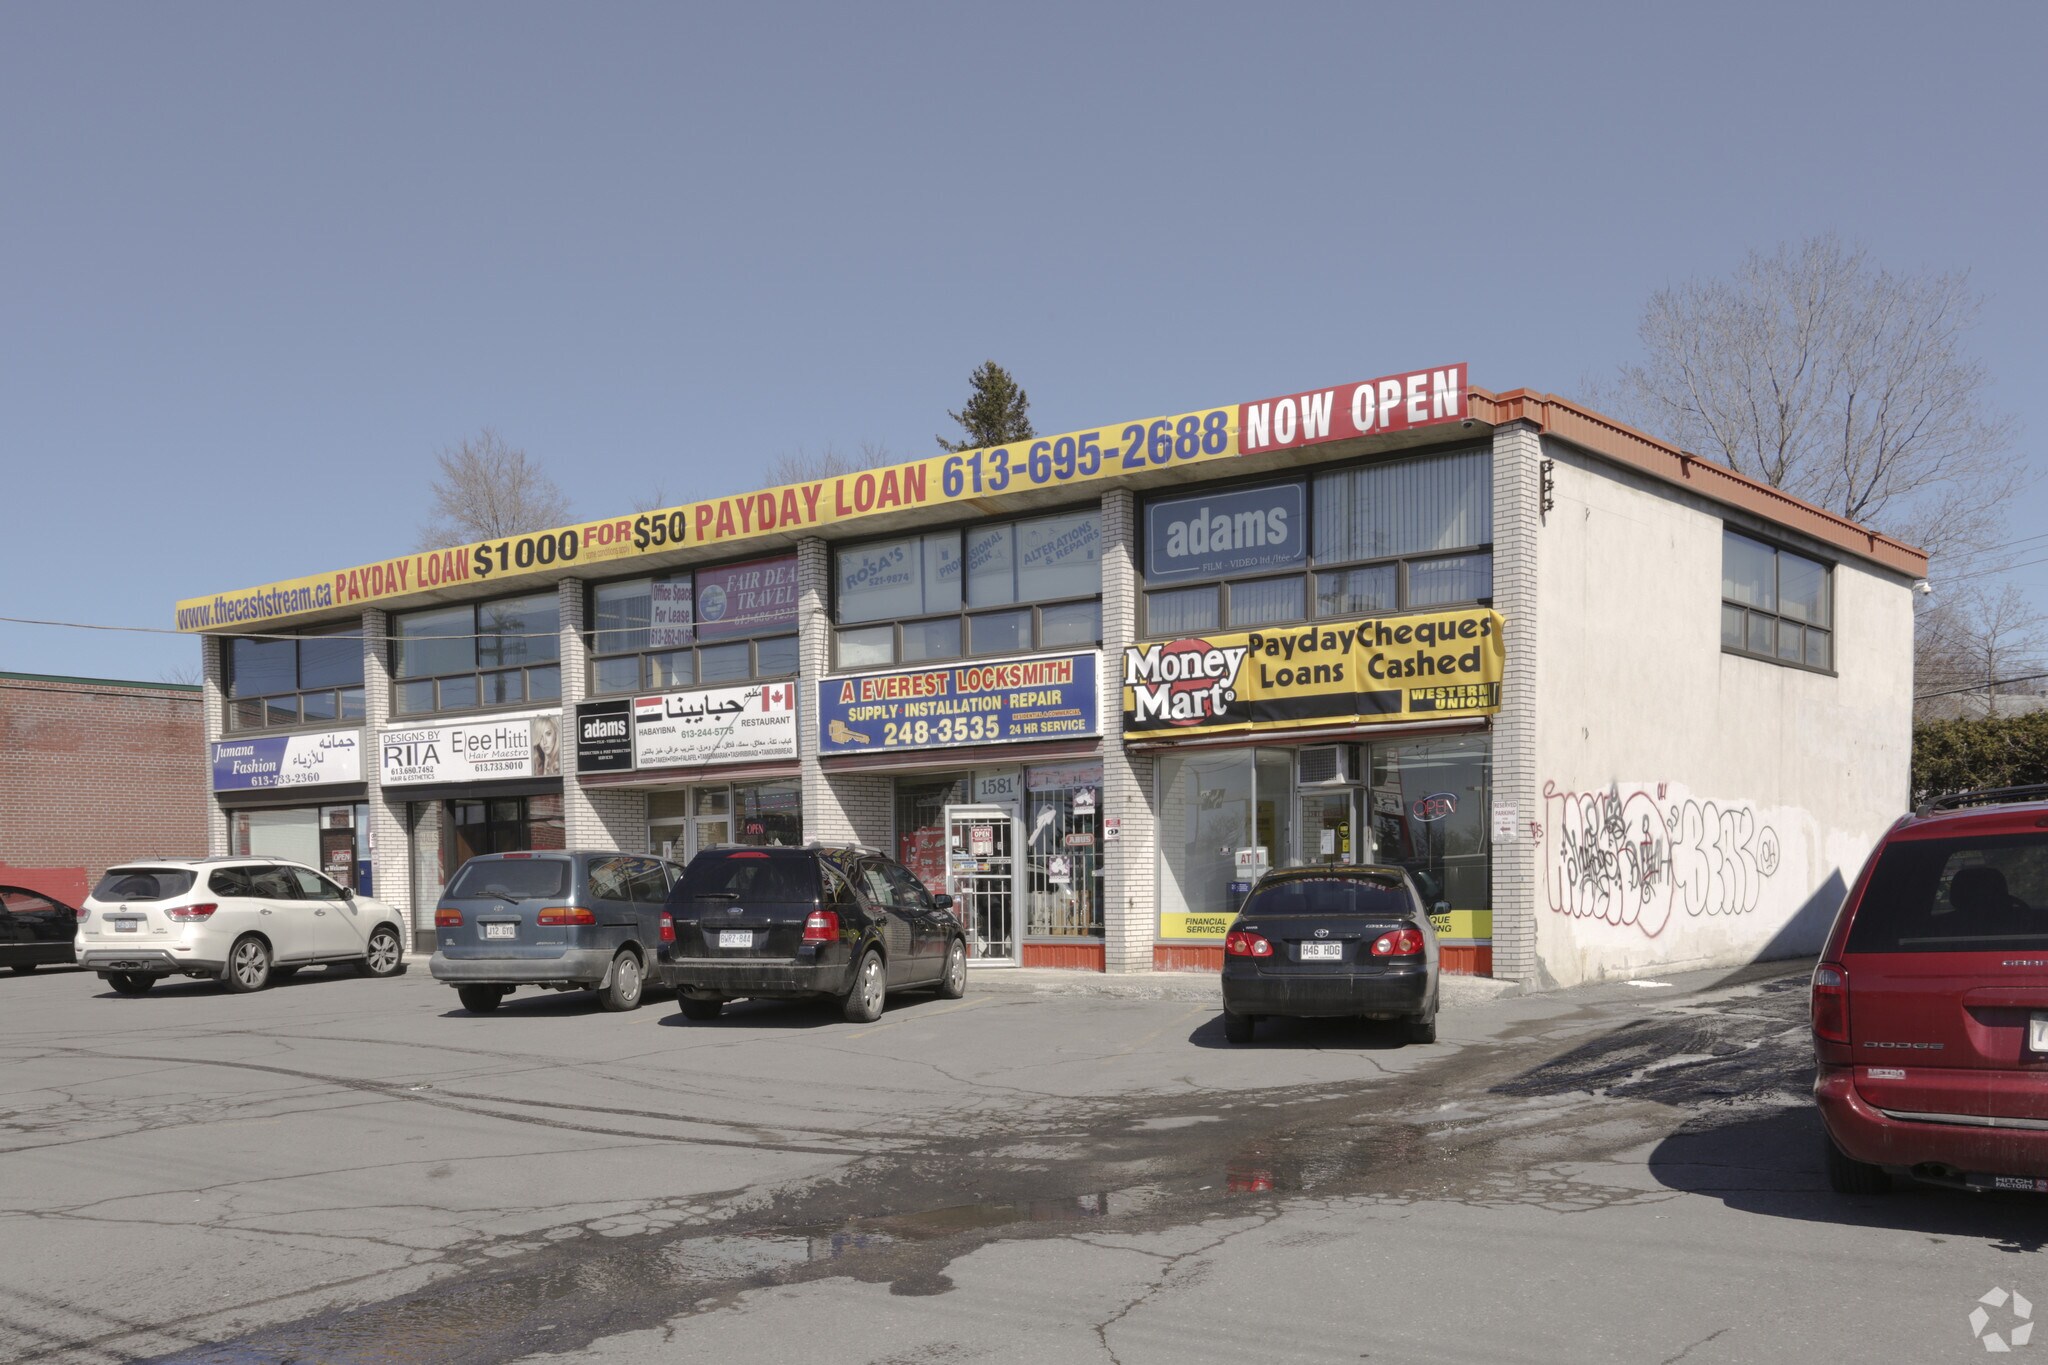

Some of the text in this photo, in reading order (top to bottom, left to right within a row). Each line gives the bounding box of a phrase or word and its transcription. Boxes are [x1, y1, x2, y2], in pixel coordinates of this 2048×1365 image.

[1247, 368, 1458, 449] NOW OPEN
[178, 410, 1228, 630] www.thecashstream.ca PAYDAY LOAN $1000 FOR $50 PAYDAY LOAN 613-695-2688
[1166, 506, 1288, 558] adams
[1024, 521, 1092, 565] ALTERATIONS
[1055, 529, 1100, 559] REPAIRS
[1202, 561, 1222, 571] FILM
[1230, 558, 1258, 567] VIDEO
[727, 566, 798, 592] FAIR DEA
[653, 584, 671, 601] Office
[672, 584, 692, 604] Space
[737, 585, 794, 610] TRAVEL
[655, 606, 690, 623] For Lease
[1249, 615, 1492, 660] Payday Cheques
[1126, 645, 1248, 688] Money
[1260, 646, 1481, 688] Loans Cashed
[838, 658, 1074, 705] A EVEREST LOCKSMITH
[1411, 684, 1488, 700] WESTERN
[665, 694, 744, 724] حبايبنا
[848, 690, 1062, 722] SUPPLY INSTALLATION REPAIR
[1134, 687, 1228, 723] Mart
[1435, 695, 1488, 710] UNION
[584, 719, 626, 738] adams
[741, 716, 790, 727] RESTAURANT
[884, 715, 999, 746] 248-3535
[1009, 719, 1086, 735] 24 HR SERVICE
[383, 732, 425, 744] DESIGNS
[427, 730, 440, 740] BY
[495, 727, 529, 750] Hitti
[638, 726, 676, 737] HABAYIBNA
[681, 726, 734, 739] 613-244-5775
[214, 744, 254, 763] Jumana
[384, 744, 440, 768] RITA
[469, 749, 529, 759] Hair Maestro
[232, 759, 276, 775] Fashion
[251, 773, 320, 787] 613-733-2360
[981, 778, 1013, 795] 1581
[1413, 798, 1457, 816] OPEN
[747, 824, 764, 834] OPEN
[1185, 917, 1227, 925] FINANCIAL
[1186, 925, 1226, 934] SERVICES
[488, 926, 500, 935] J12
[1303, 945, 1319, 955] H46
